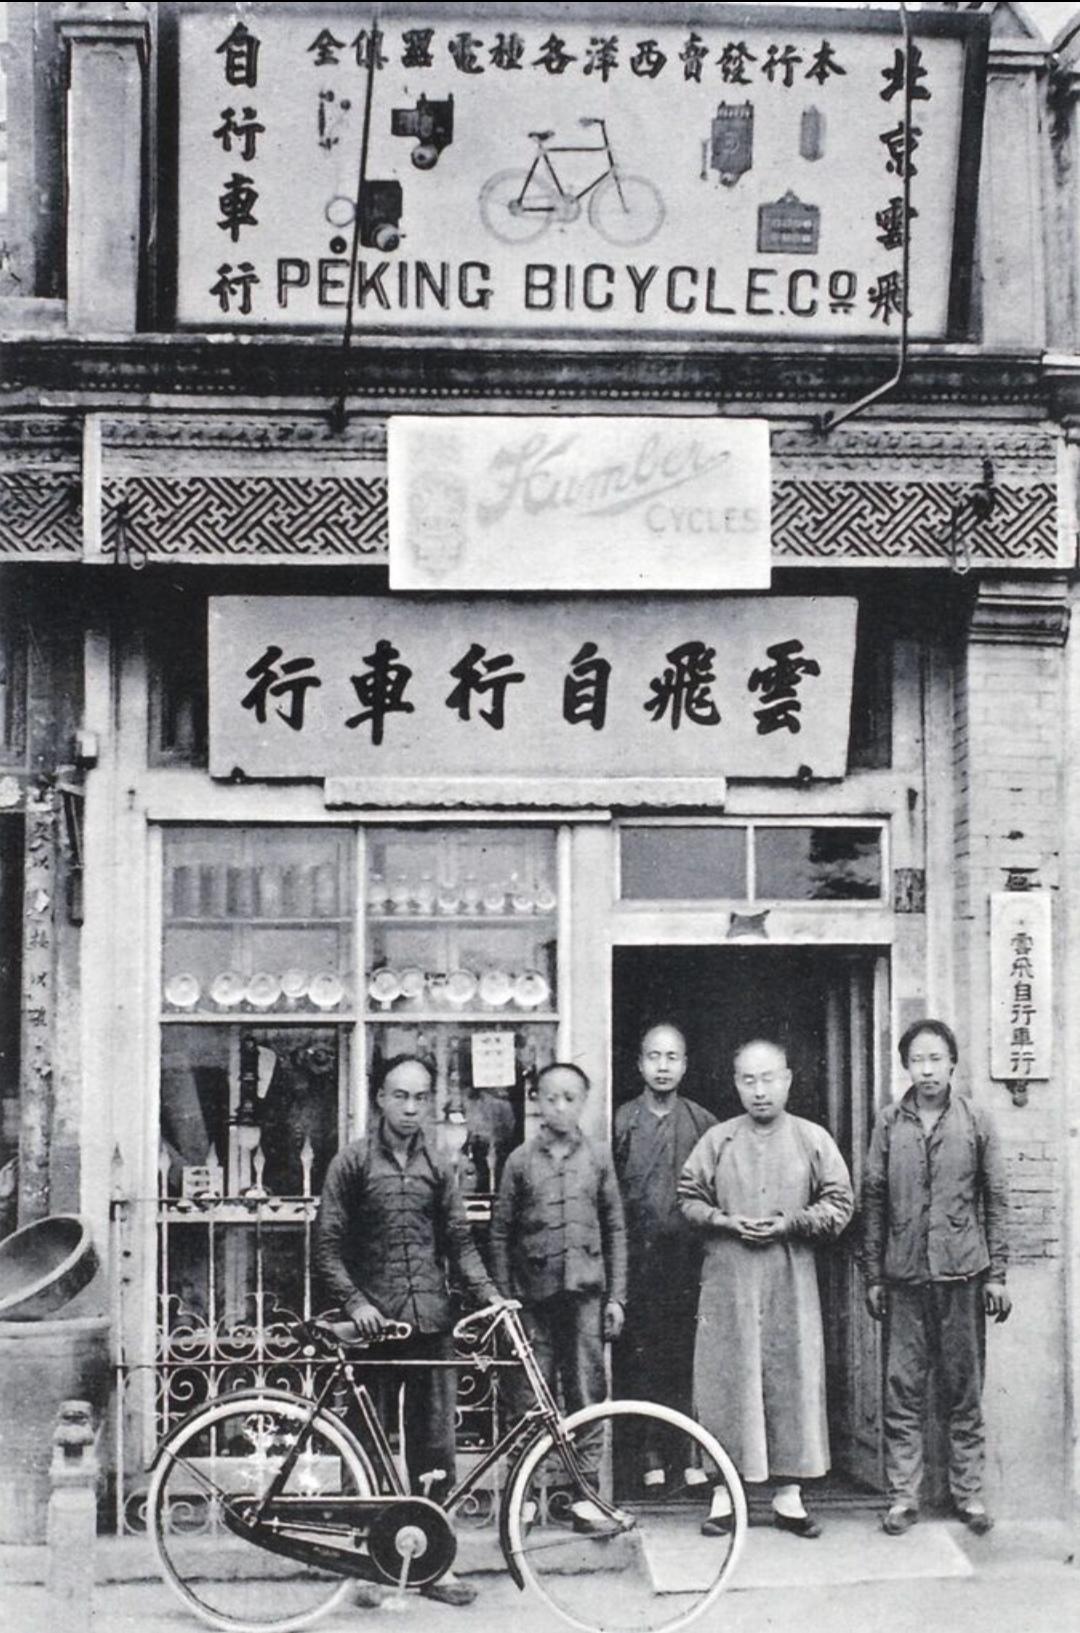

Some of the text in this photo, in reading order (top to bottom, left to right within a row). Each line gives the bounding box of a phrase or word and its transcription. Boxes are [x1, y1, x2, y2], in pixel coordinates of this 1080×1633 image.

[209, 22, 265, 315] 自行車行
[277, 258, 494, 310] PEKING
[477, 433, 731, 527] Humber
[645, 502, 759, 534] CYCLES
[241, 640, 821, 746] 雲飛自行車行
[1010, 932, 1037, 1075] 雲飛自行車行
